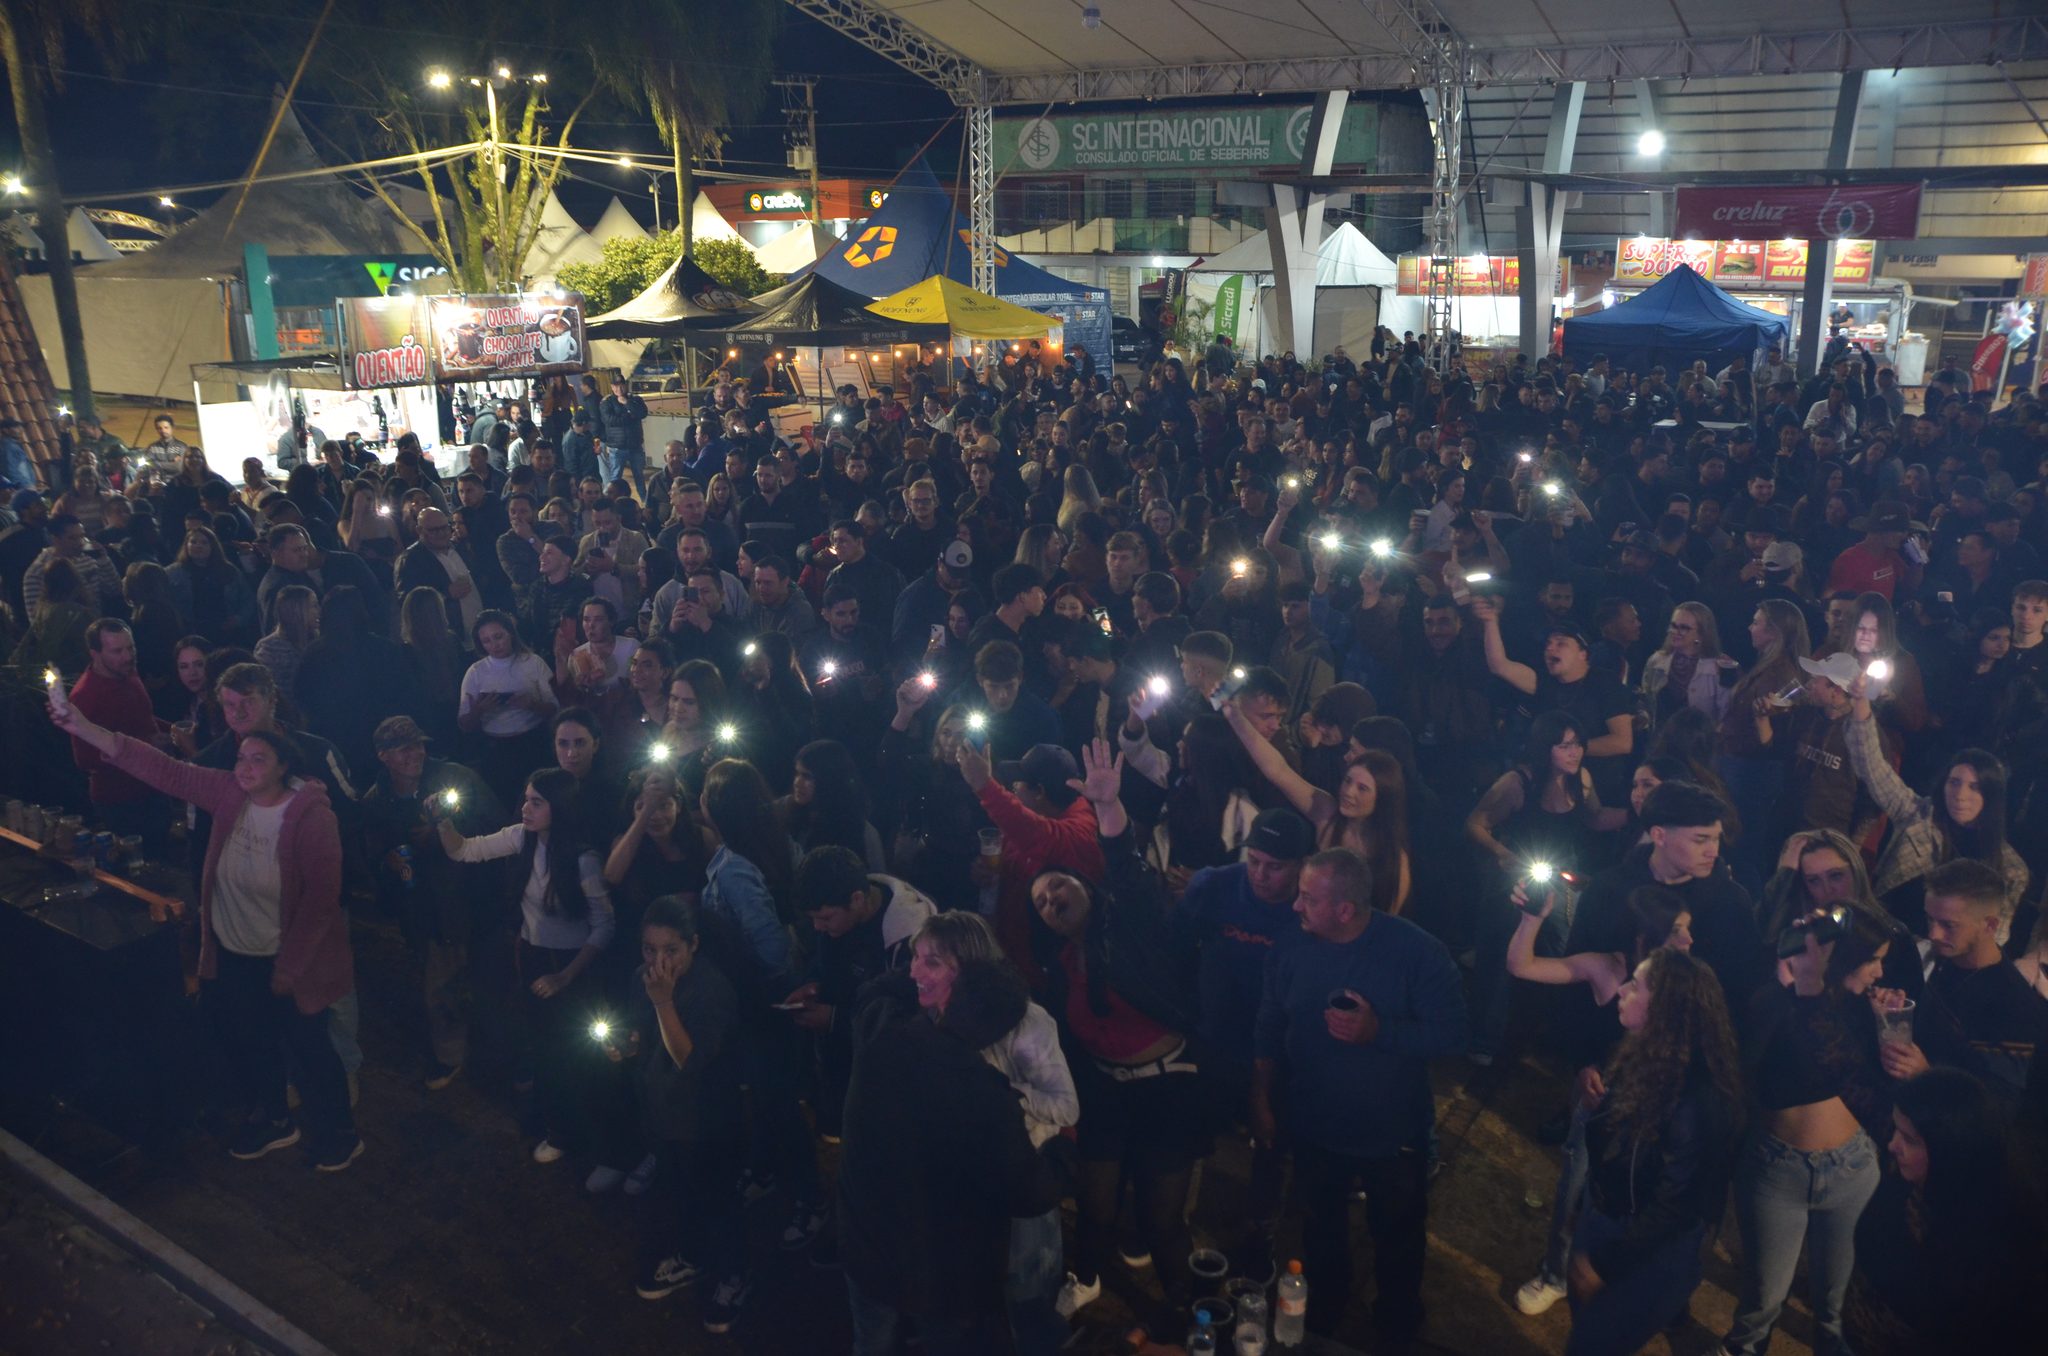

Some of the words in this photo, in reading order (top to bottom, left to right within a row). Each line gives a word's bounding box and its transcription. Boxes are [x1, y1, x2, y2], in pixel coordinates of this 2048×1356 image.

[1072, 122, 1098, 150] SC
[1103, 115, 1270, 150] INTERNACIONAL
[1076, 150, 1139, 164] CONSULADO
[1141, 150, 1185, 163] OFICIAL
[1190, 149, 1206, 161] DE
[1712, 200, 1788, 221] creluz
[1725, 244, 1760, 254] XIS
[1091, 292, 1104, 300] STAR
[1082, 310, 1096, 319] STAR
[1221, 287, 1235, 329] Sicredi
[483, 331, 542, 355] CHOCOLATE
[355, 335, 425, 388] QUENTÃO
[496, 350, 536, 370] QUENTE
